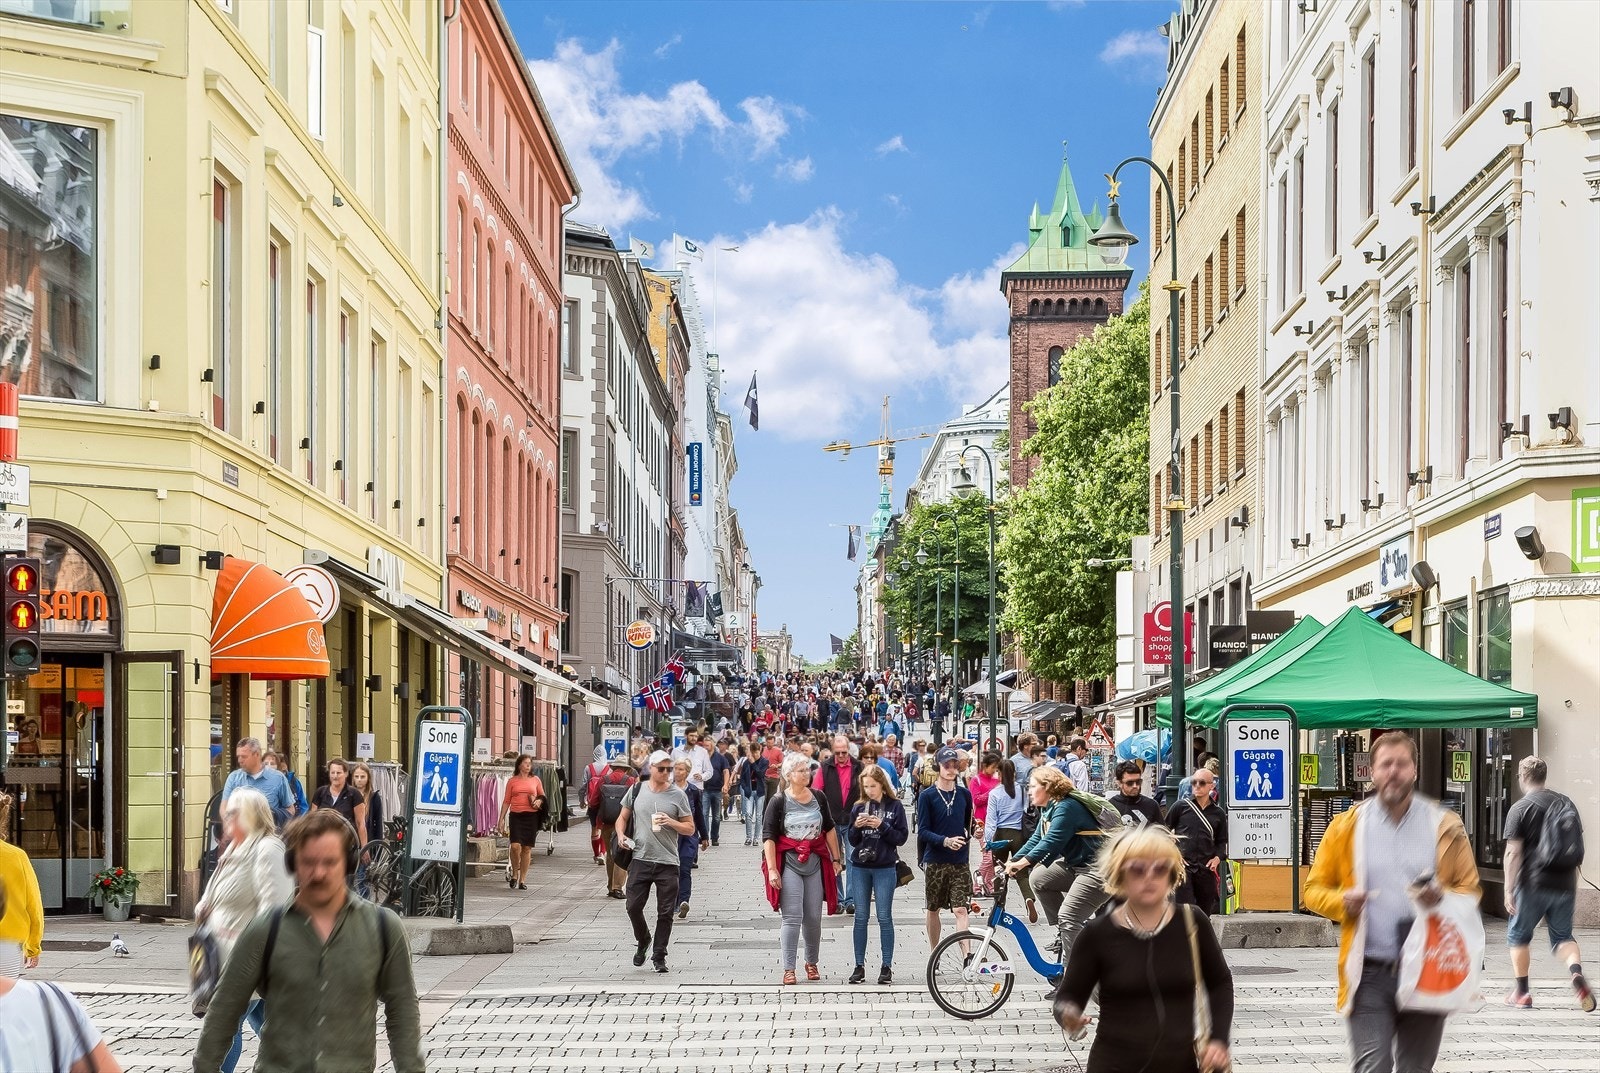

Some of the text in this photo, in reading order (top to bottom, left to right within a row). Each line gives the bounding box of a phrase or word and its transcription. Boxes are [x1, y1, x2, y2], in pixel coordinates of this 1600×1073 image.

[628, 632, 652, 642] KING
[1251, 632, 1281, 640] BIANC
[428, 727, 458, 744] Sone
[606, 729, 625, 737] Sone
[1238, 725, 1280, 740] Sone
[429, 753, 453, 764] Gågate
[1242, 751, 1276, 762] Gågate
[417, 817, 458, 828] Varetransport
[425, 838, 434, 846] 00
